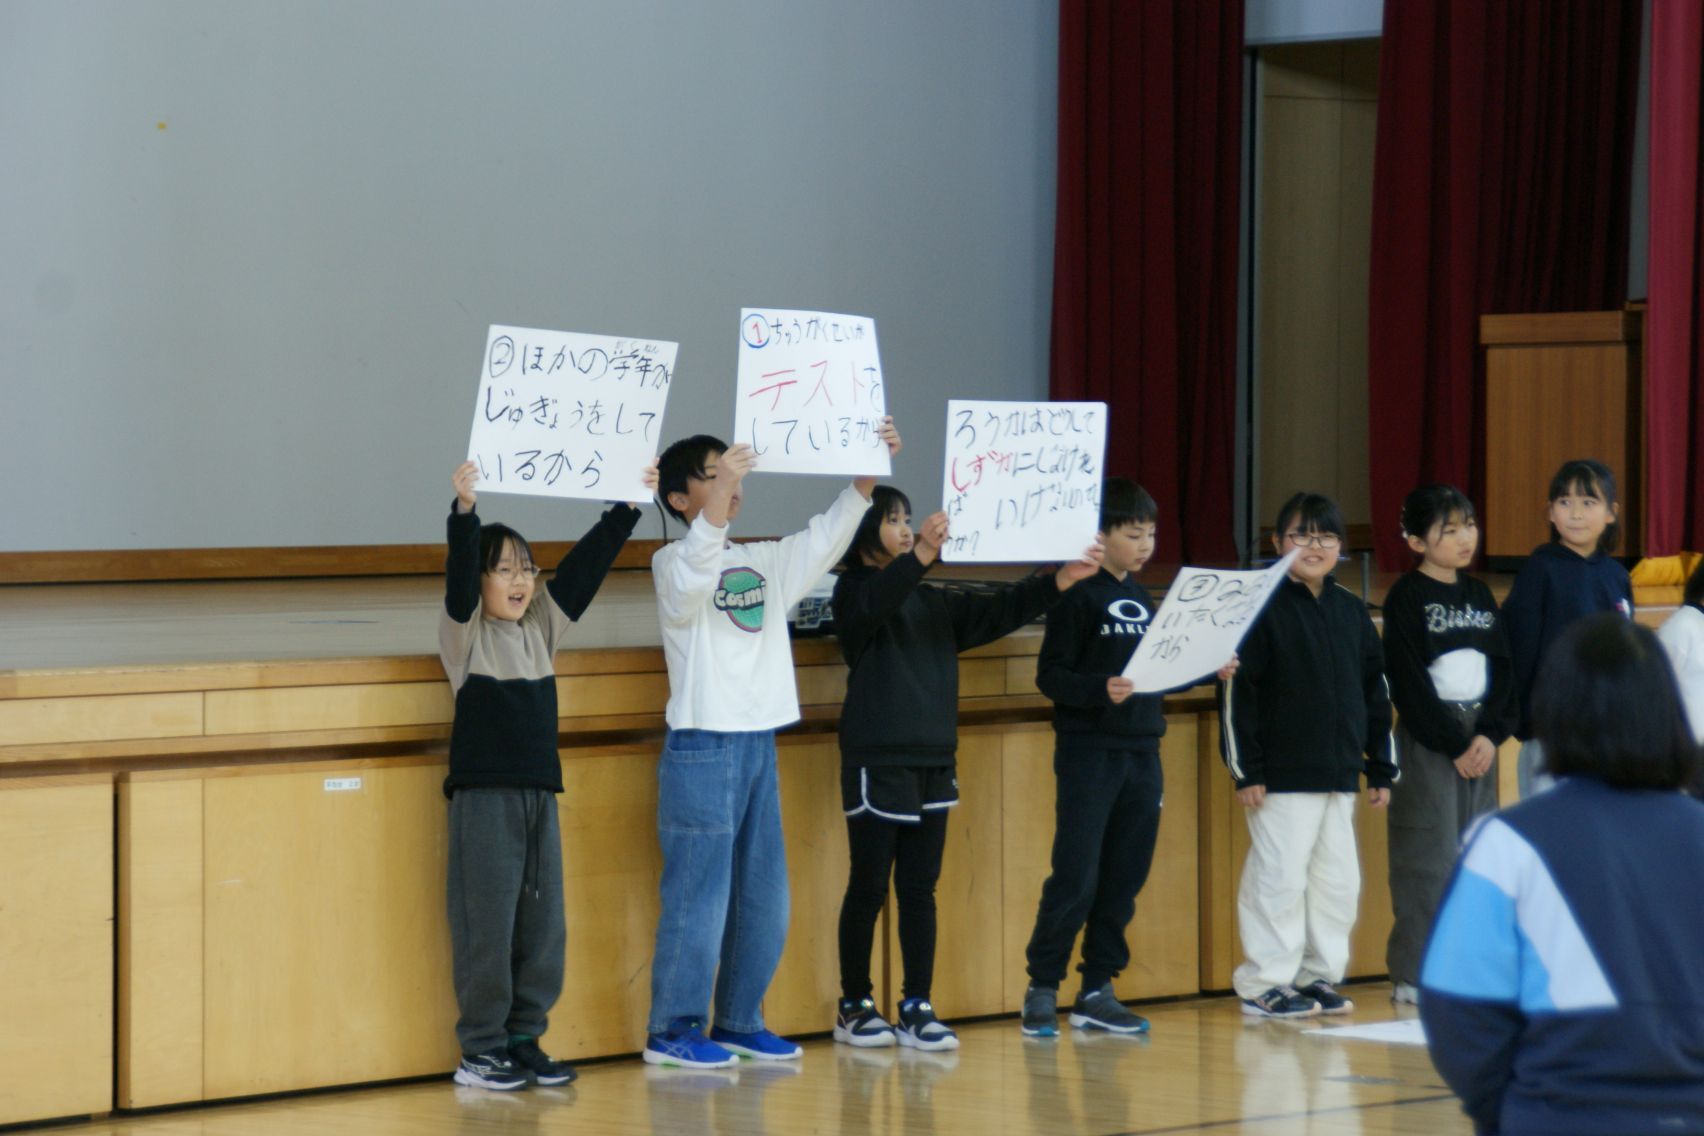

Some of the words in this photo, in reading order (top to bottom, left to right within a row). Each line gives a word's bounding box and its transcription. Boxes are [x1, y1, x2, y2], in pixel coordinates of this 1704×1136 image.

[485, 385, 656, 442] じゅぎょうをして
[477, 449, 604, 489] いるから
